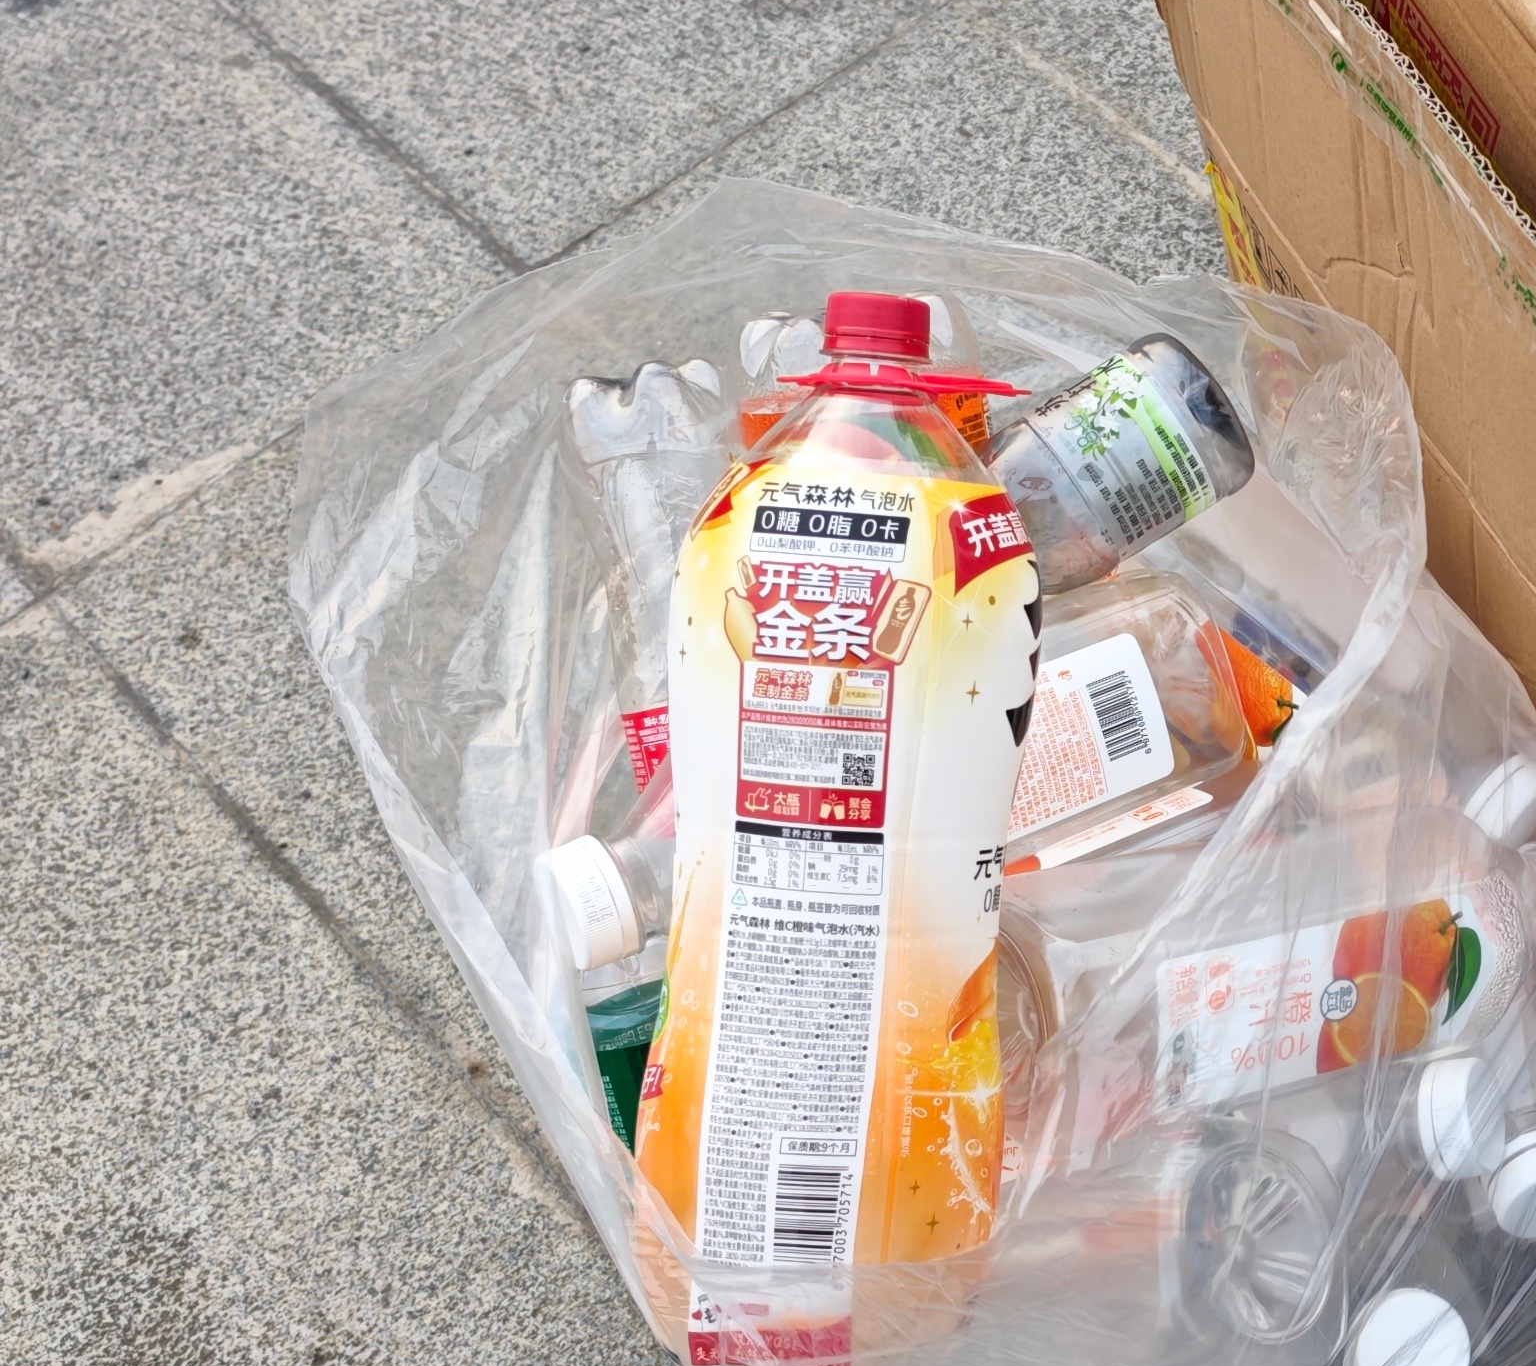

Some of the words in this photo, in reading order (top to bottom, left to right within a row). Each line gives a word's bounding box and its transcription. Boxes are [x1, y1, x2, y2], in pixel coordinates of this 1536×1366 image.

[759, 482, 855, 509] 元气森林
[860, 490, 915, 512] 气泡水
[759, 563, 876, 606] 开盖赢
[755, 601, 872, 661] 金条
[755, 668, 813, 686] 元气森林
[753, 684, 809, 701] 定制金条
[782, 828, 832, 840] 营养成分表
